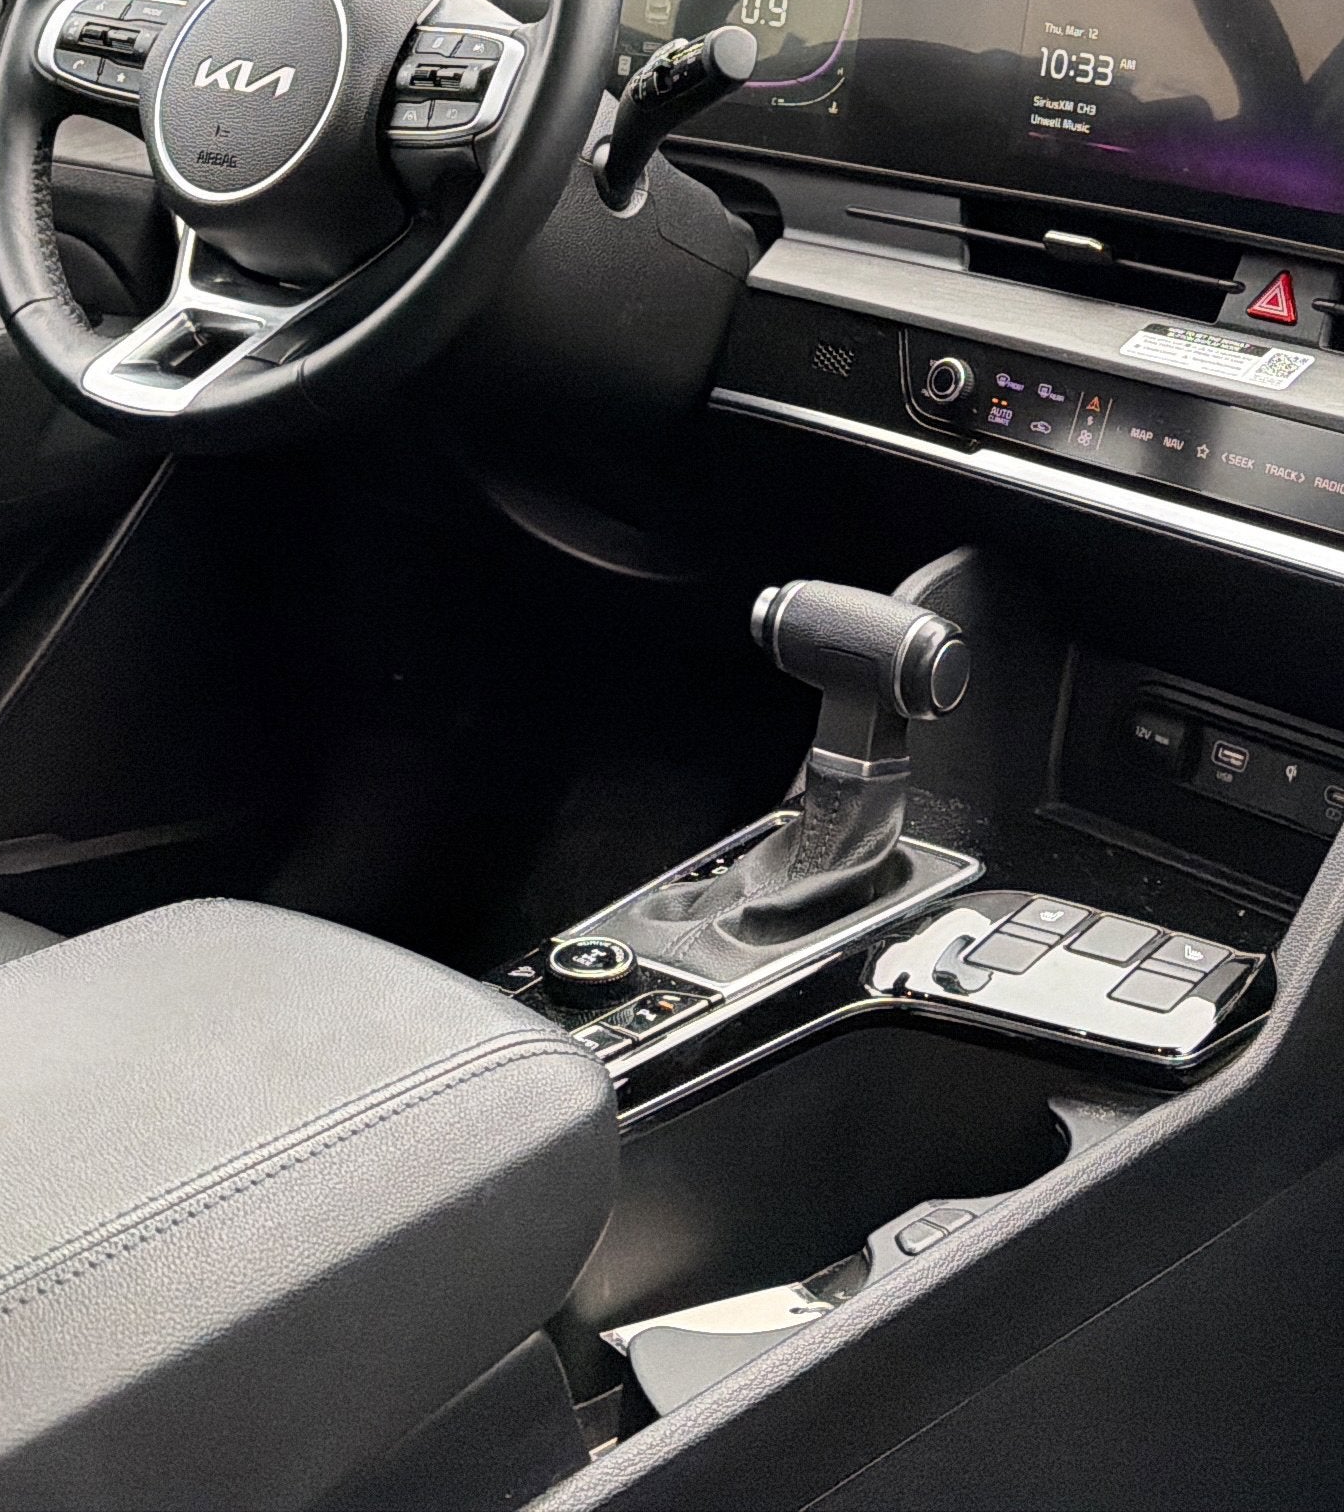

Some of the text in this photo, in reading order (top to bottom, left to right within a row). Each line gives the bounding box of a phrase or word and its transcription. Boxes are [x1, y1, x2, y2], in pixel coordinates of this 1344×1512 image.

[1044, 21, 1064, 36] Thu,
[1088, 28, 1099, 40] 12
[1039, 46, 1137, 86] 10:33 AM
[1033, 95, 1097, 116] SiriusXM CH3
[1030, 113, 1092, 134] Unwell Music
[196, 149, 239, 169] AIRBAG
[990, 406, 1013, 420] AUTO
[1130, 427, 1154, 442] MAP
[1162, 436, 1185, 451] NAV
[1228, 454, 1256, 470] SEEK
[1265, 463, 1299, 483] TRACK
[1134, 724, 1152, 741] 12V
